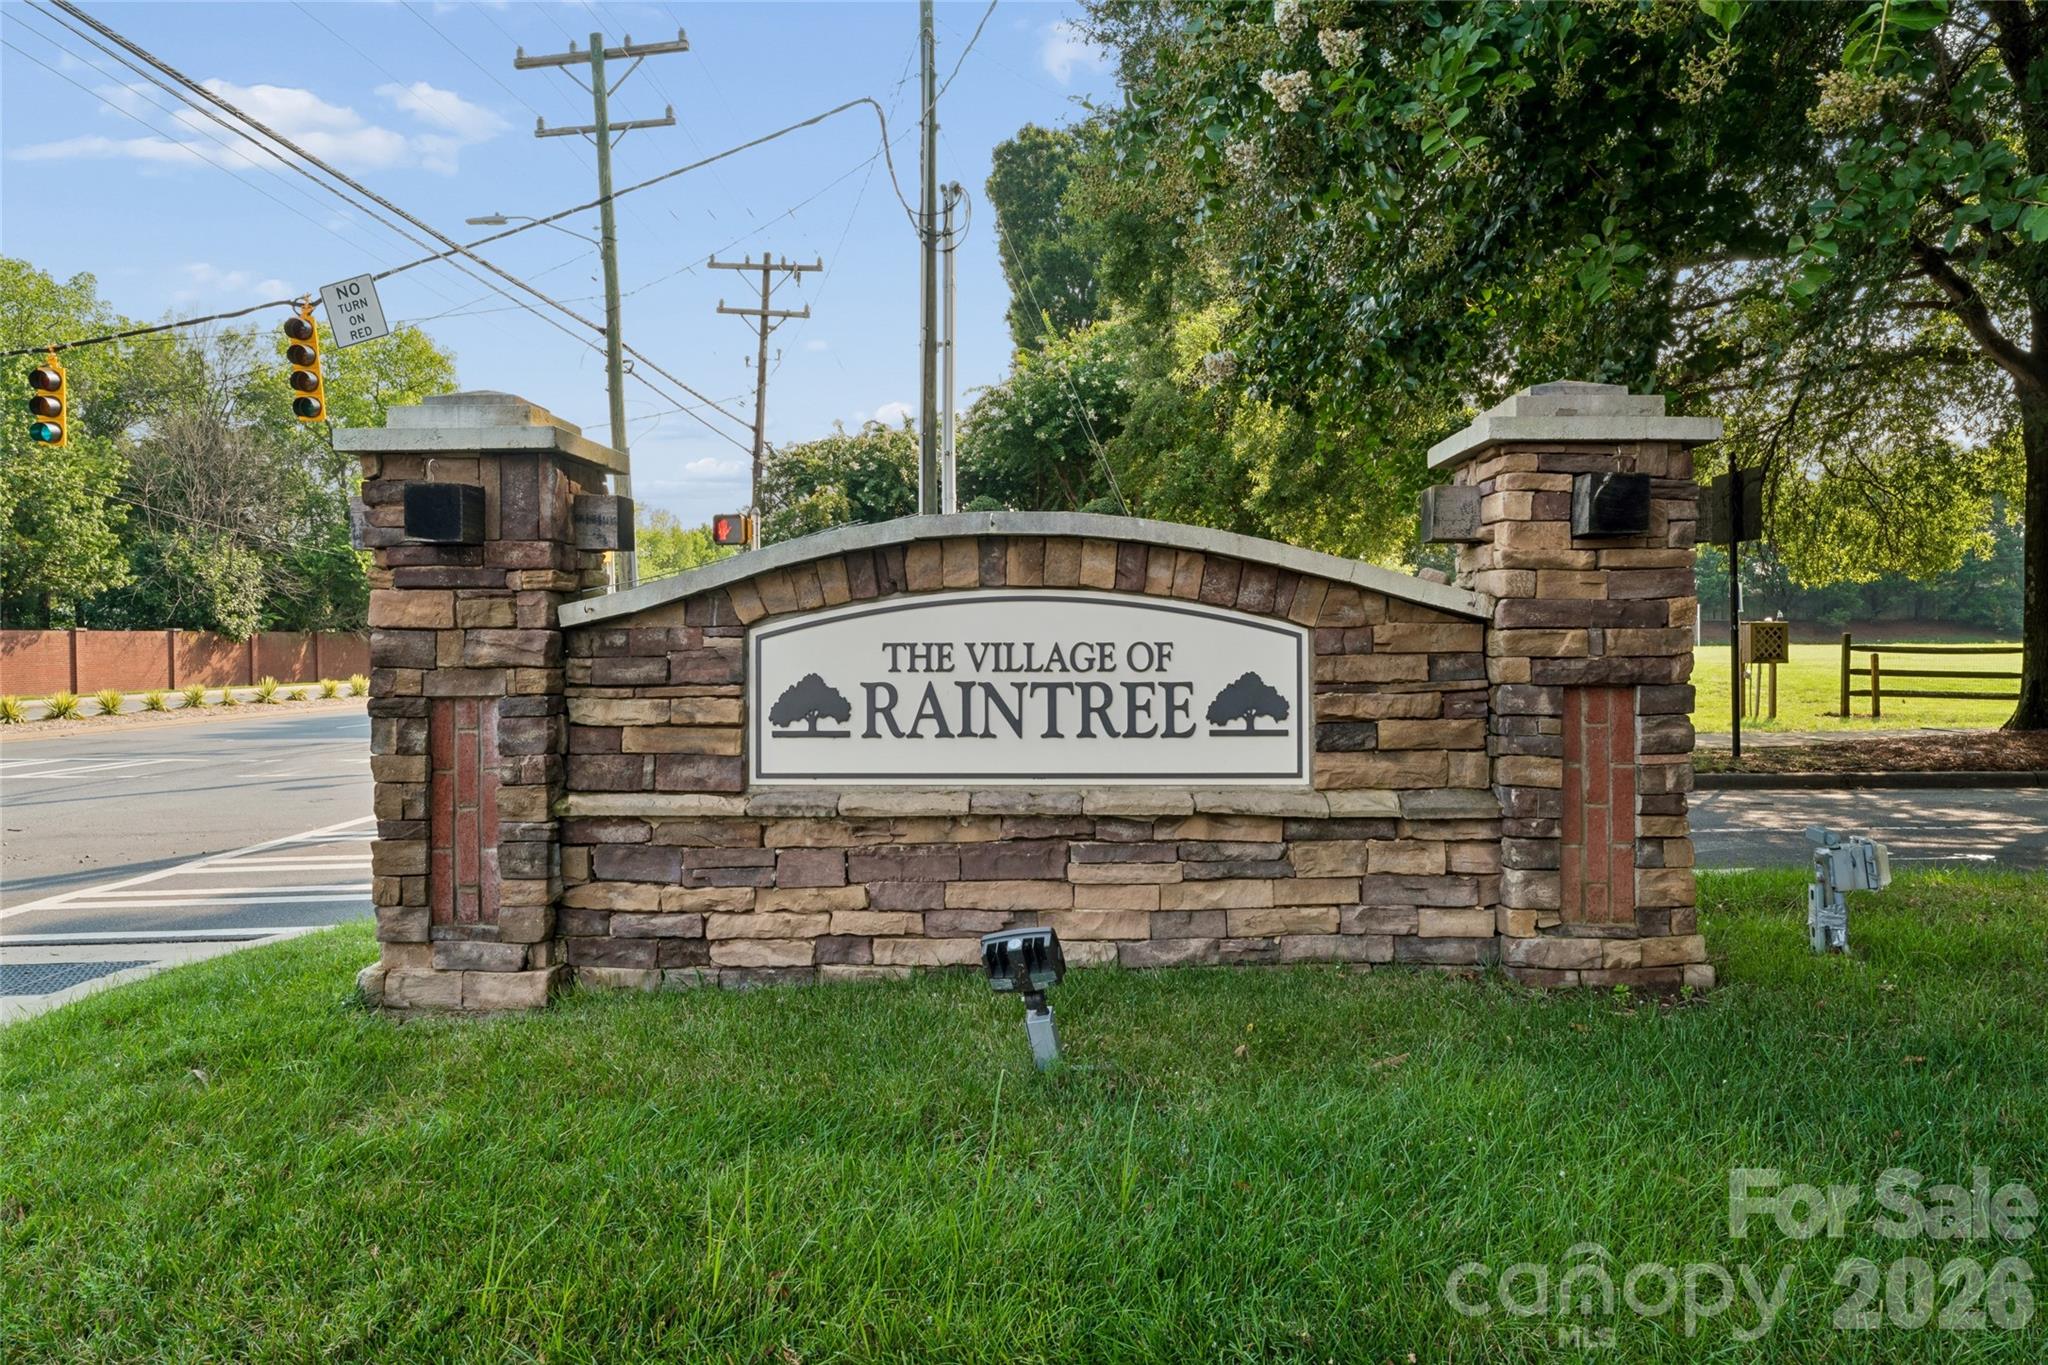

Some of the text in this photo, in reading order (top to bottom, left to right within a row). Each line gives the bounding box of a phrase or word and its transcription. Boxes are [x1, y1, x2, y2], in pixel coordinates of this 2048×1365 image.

[336, 282, 360, 300] NO
[338, 298, 368, 314] TURN
[349, 313, 366, 326] ON
[350, 326, 372, 341] RED
[882, 641, 1174, 673] THE VILLAGE OF
[860, 680, 1197, 740] RAINTREE
